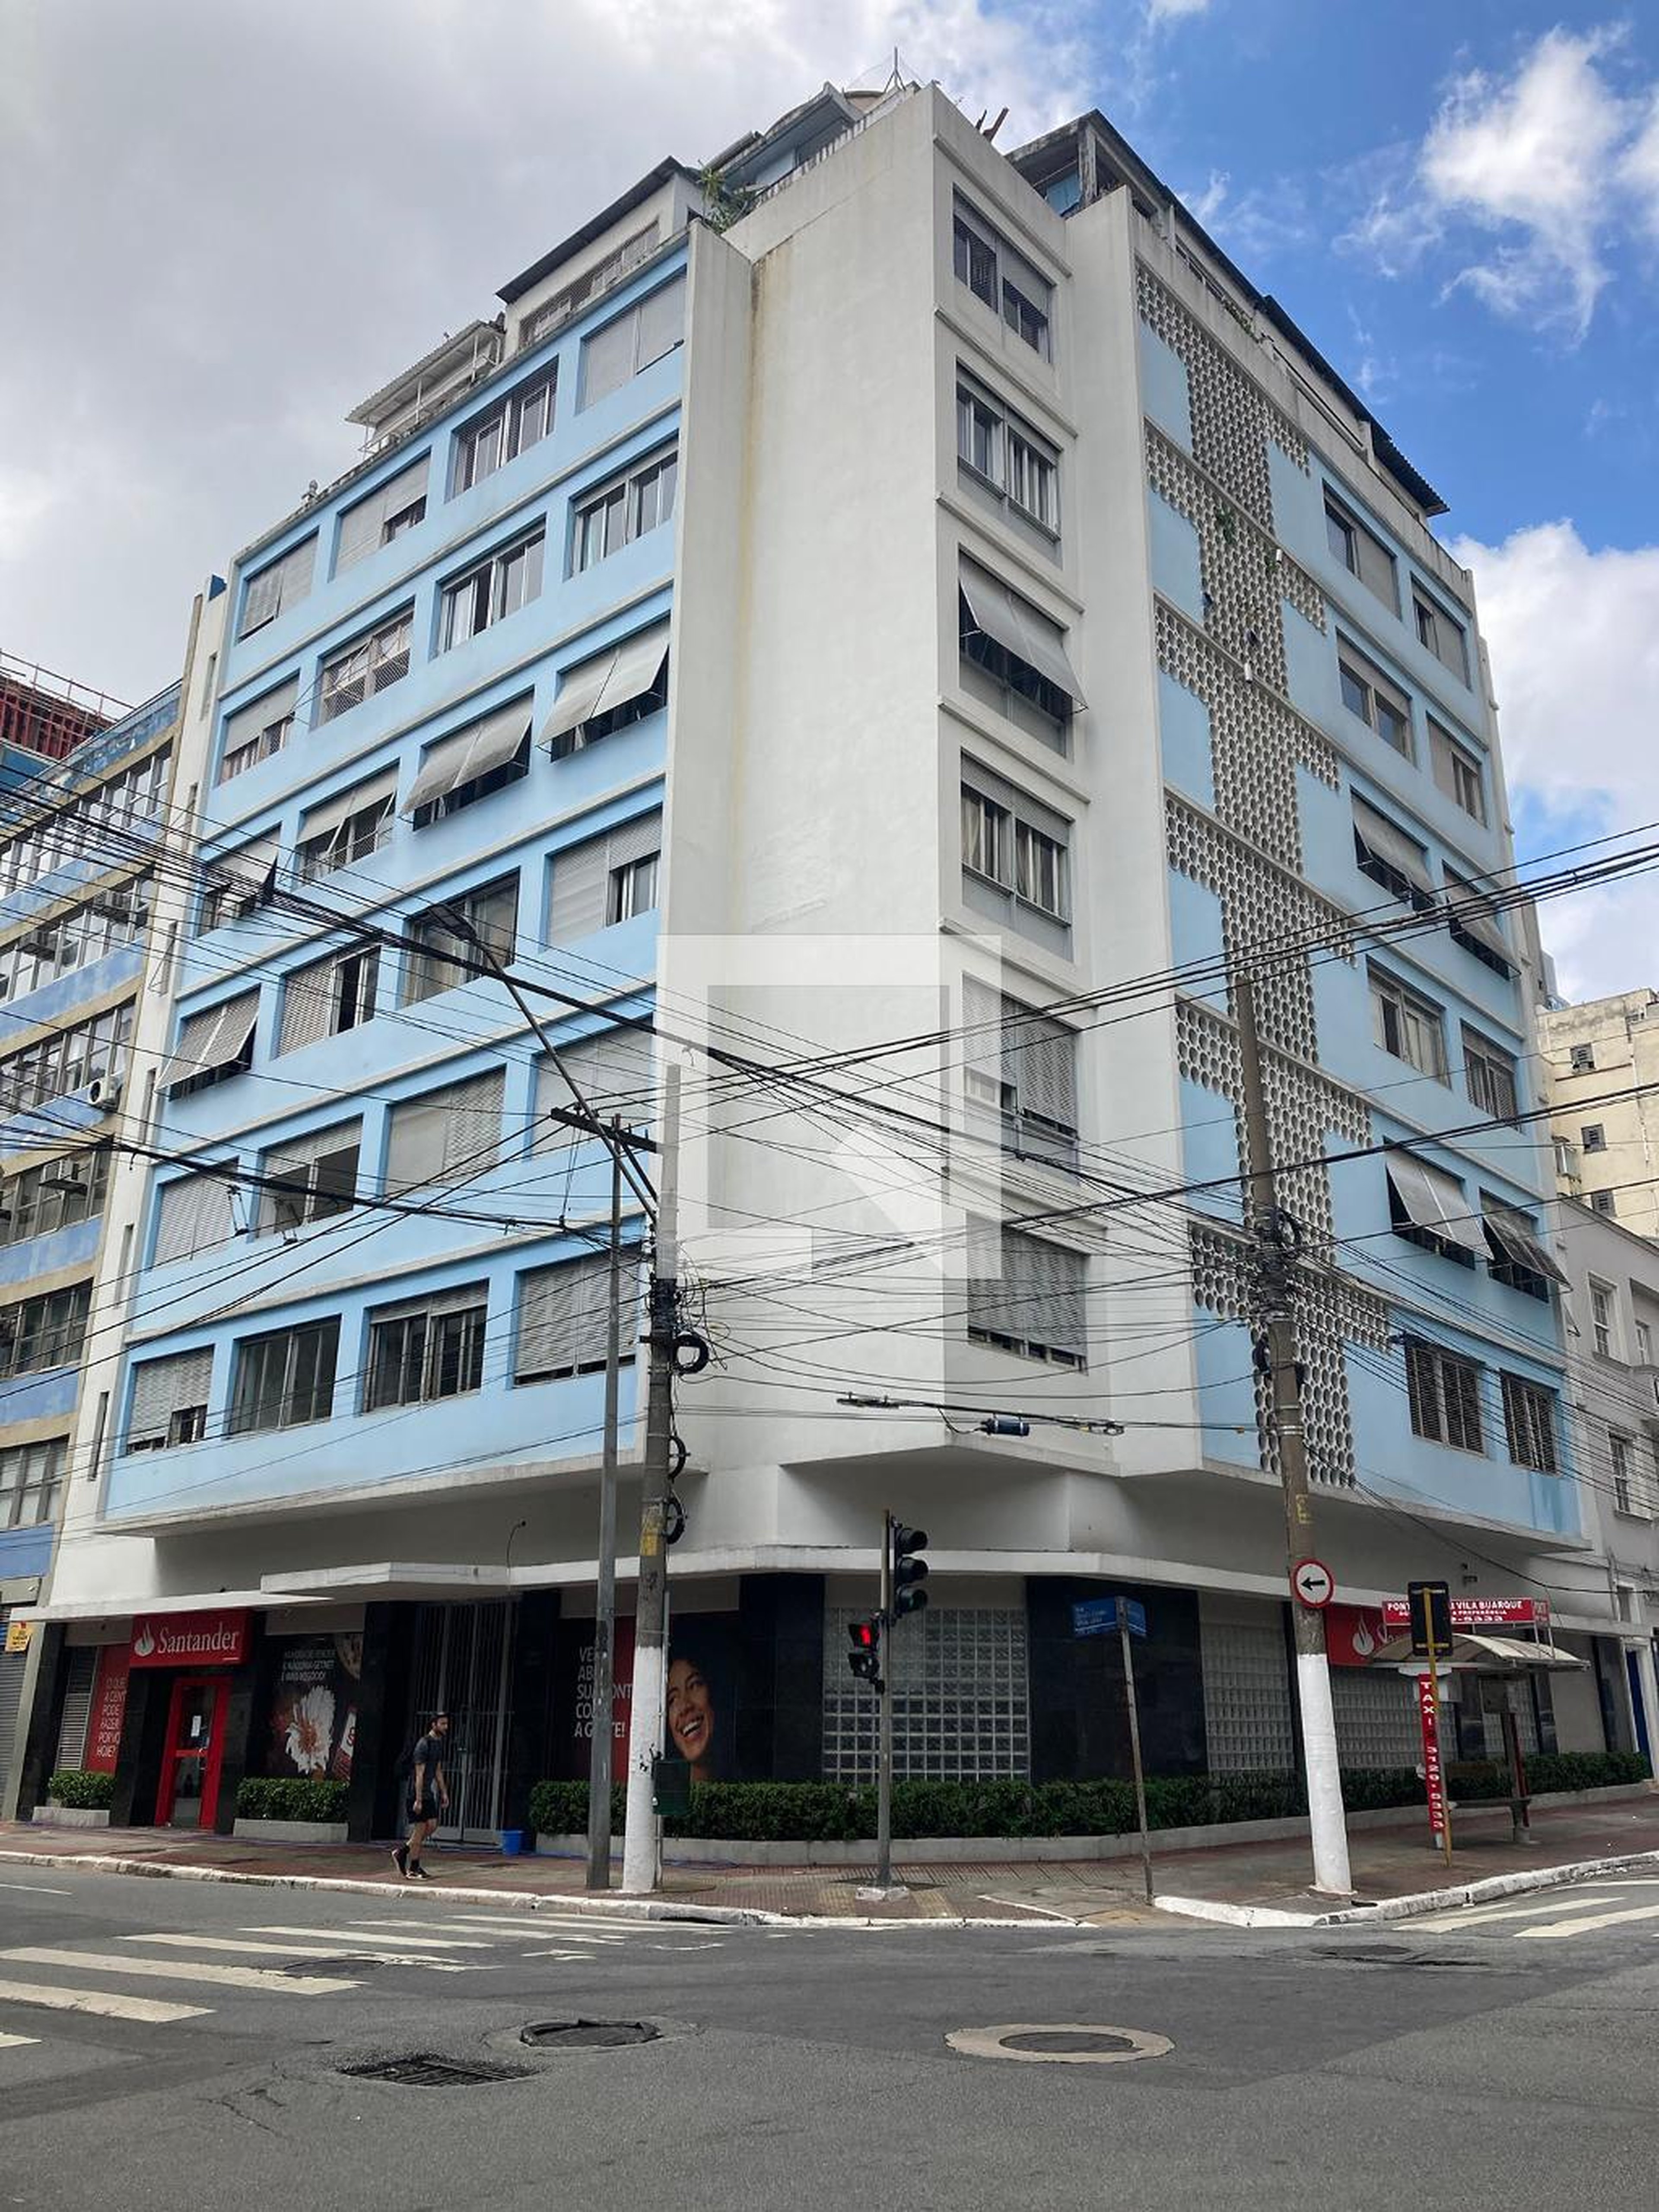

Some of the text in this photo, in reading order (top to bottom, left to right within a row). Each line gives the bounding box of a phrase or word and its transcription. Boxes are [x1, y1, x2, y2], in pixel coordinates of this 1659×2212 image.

[1388, 1602, 1410, 1611] PONT
[1456, 1601, 1478, 1610] VILA
[1479, 1600, 1522, 1609] BUARQUE
[157, 1621, 239, 1654] Santander
[1421, 1681, 1434, 1725] TAXI
